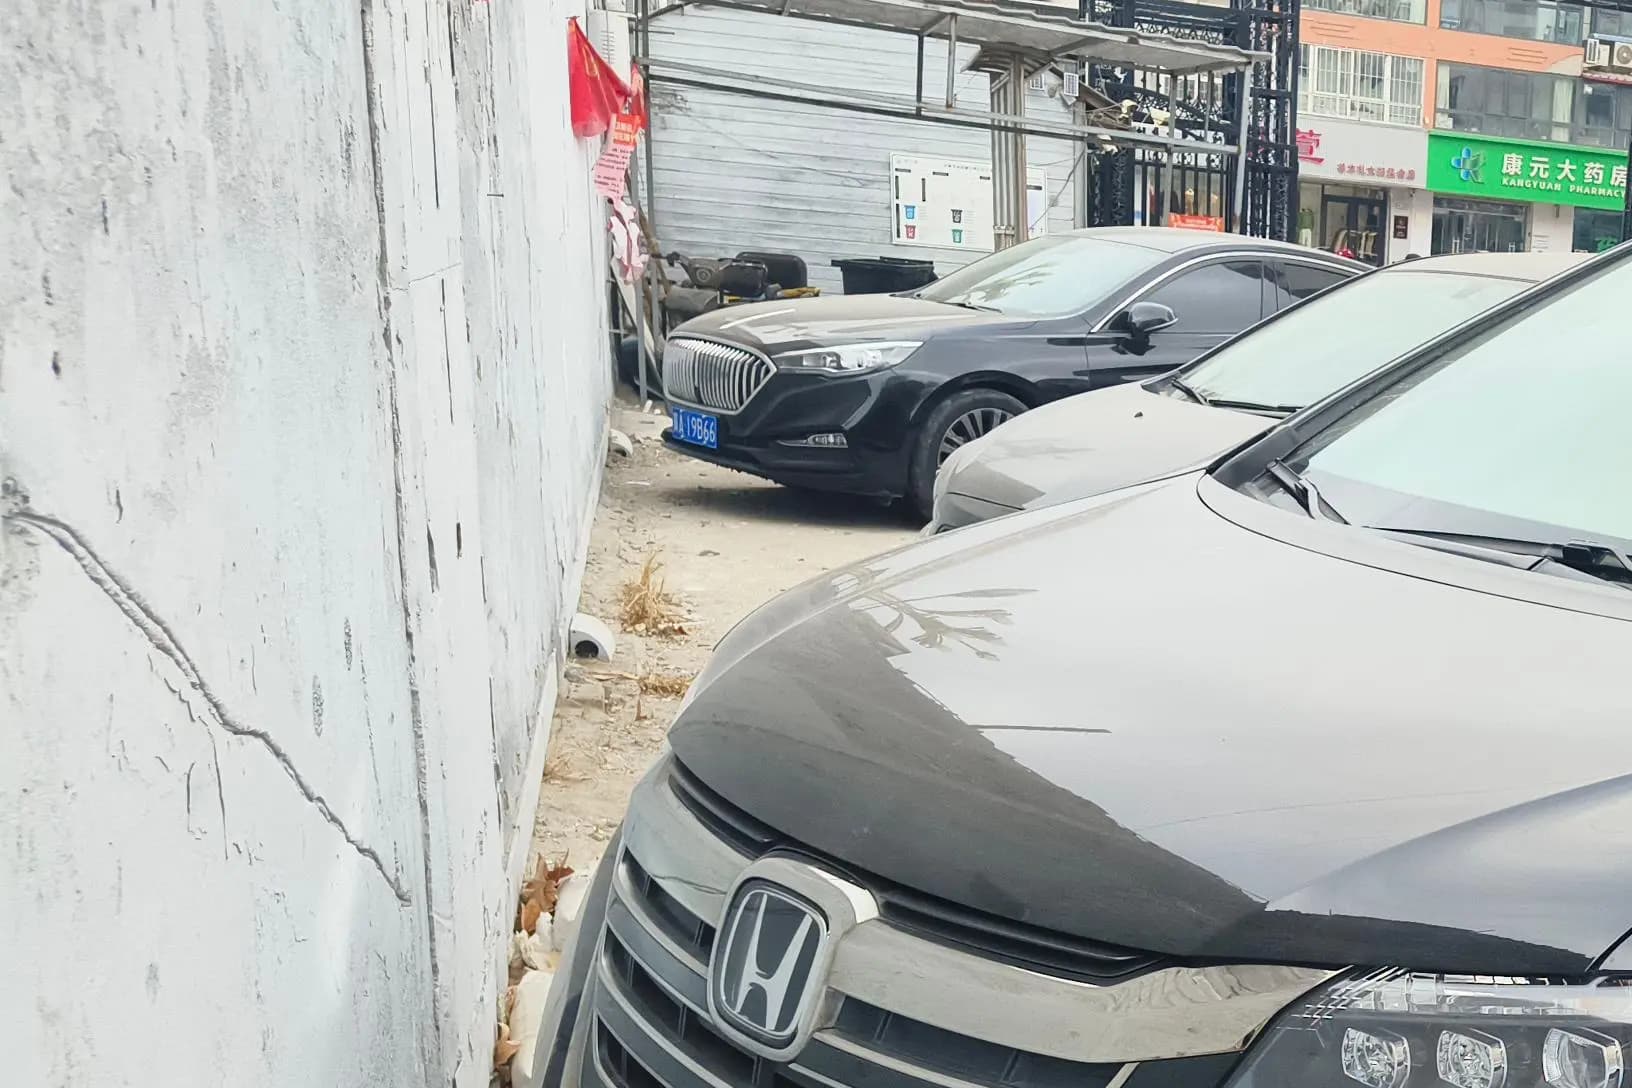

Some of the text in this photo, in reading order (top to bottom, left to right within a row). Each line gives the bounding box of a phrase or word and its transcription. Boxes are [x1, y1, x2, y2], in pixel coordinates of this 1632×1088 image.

[1501, 153, 1627, 187] 康元大药房
[1502, 177, 1626, 198] KANGYUAN PHARMACY
